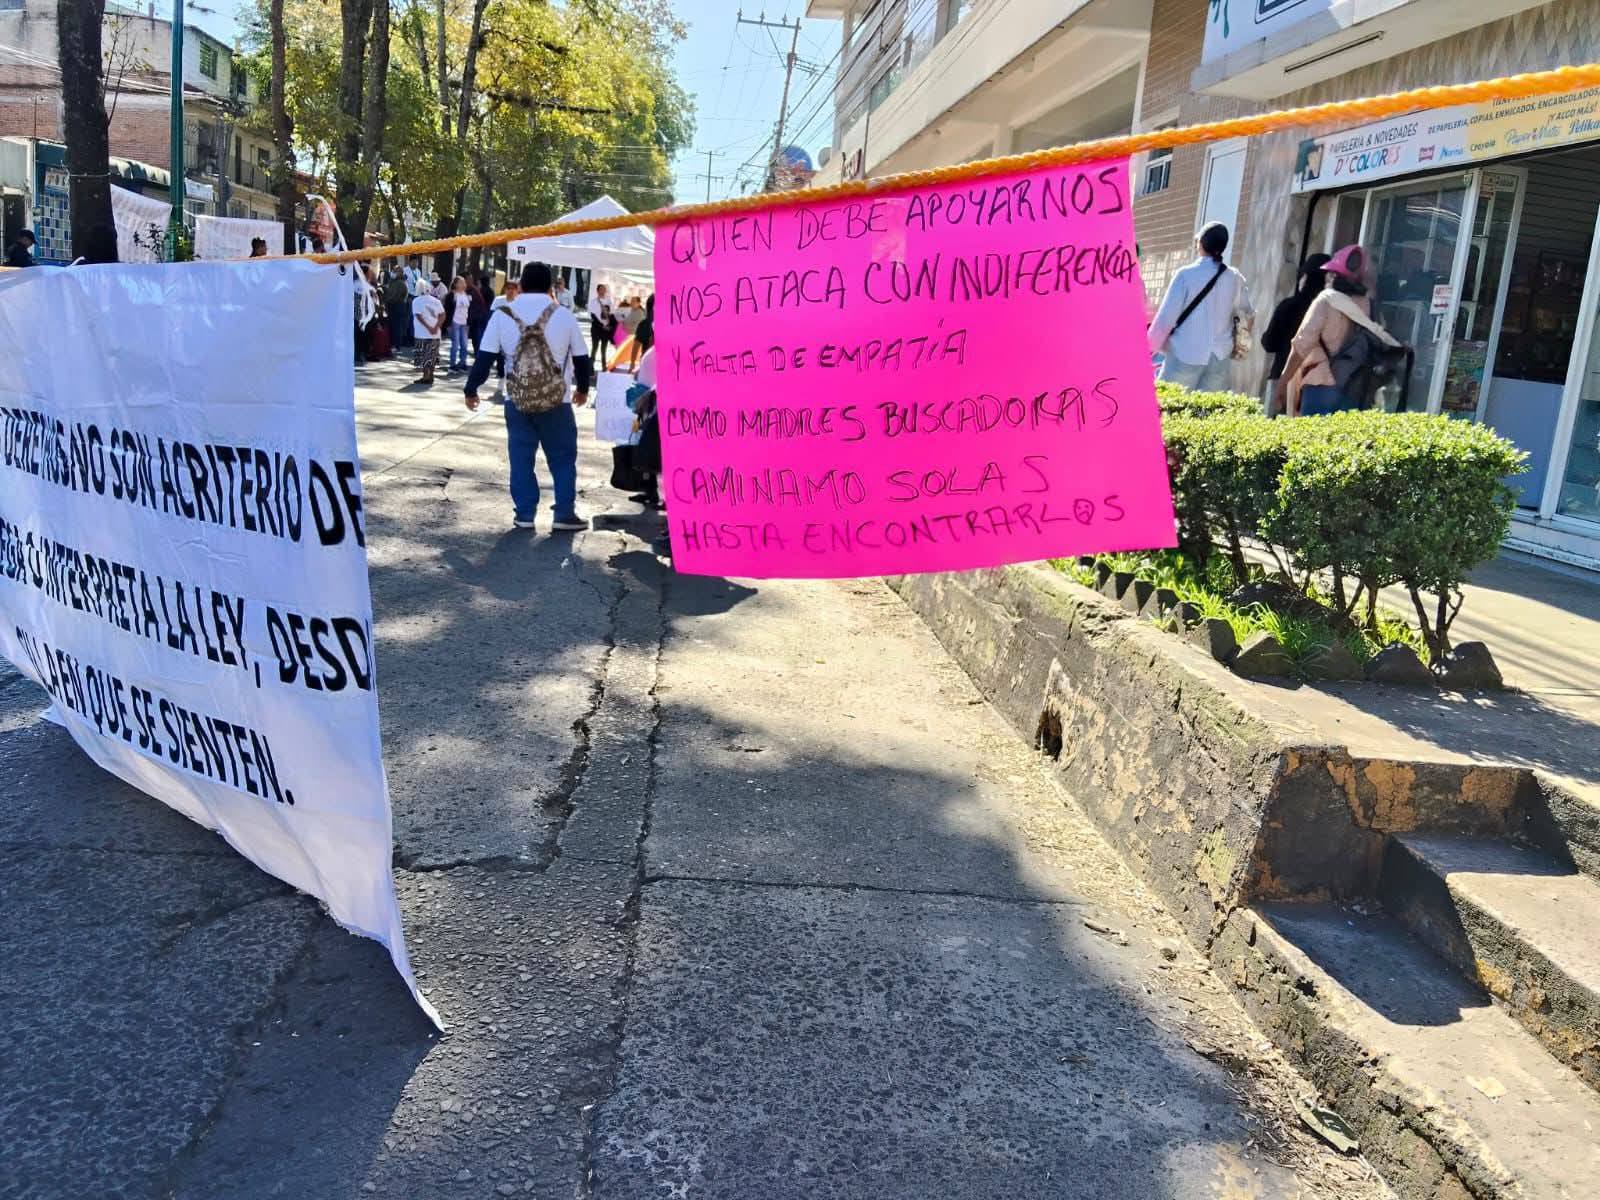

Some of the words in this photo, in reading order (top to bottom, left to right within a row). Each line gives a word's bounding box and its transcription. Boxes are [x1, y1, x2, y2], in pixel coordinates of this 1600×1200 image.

[1374, 122, 1419, 145] NOVEDADES
[670, 209, 773, 264] QUIEN
[794, 201, 888, 250] DEBE
[669, 282, 723, 325] NOS
[735, 265, 847, 315] ATACA
[864, 253, 941, 304] CON
[671, 344, 682, 382] Y
[690, 341, 758, 376] FALTA
[768, 345, 808, 372] DE
[667, 406, 727, 440] COMO
[738, 405, 867, 442] MADRES
[71, 423, 106, 495] NO
[110, 427, 157, 511] SON
[672, 466, 867, 510] CAMINAMO
[887, 455, 1050, 503] SOLAS
[682, 519, 788, 551] HASTA
[157, 576, 199, 655] LA
[266, 606, 374, 692] DESD
[86, 665, 133, 742] QUE
[131, 685, 163, 756] SE
[159, 697, 294, 806] SIENTEN.
